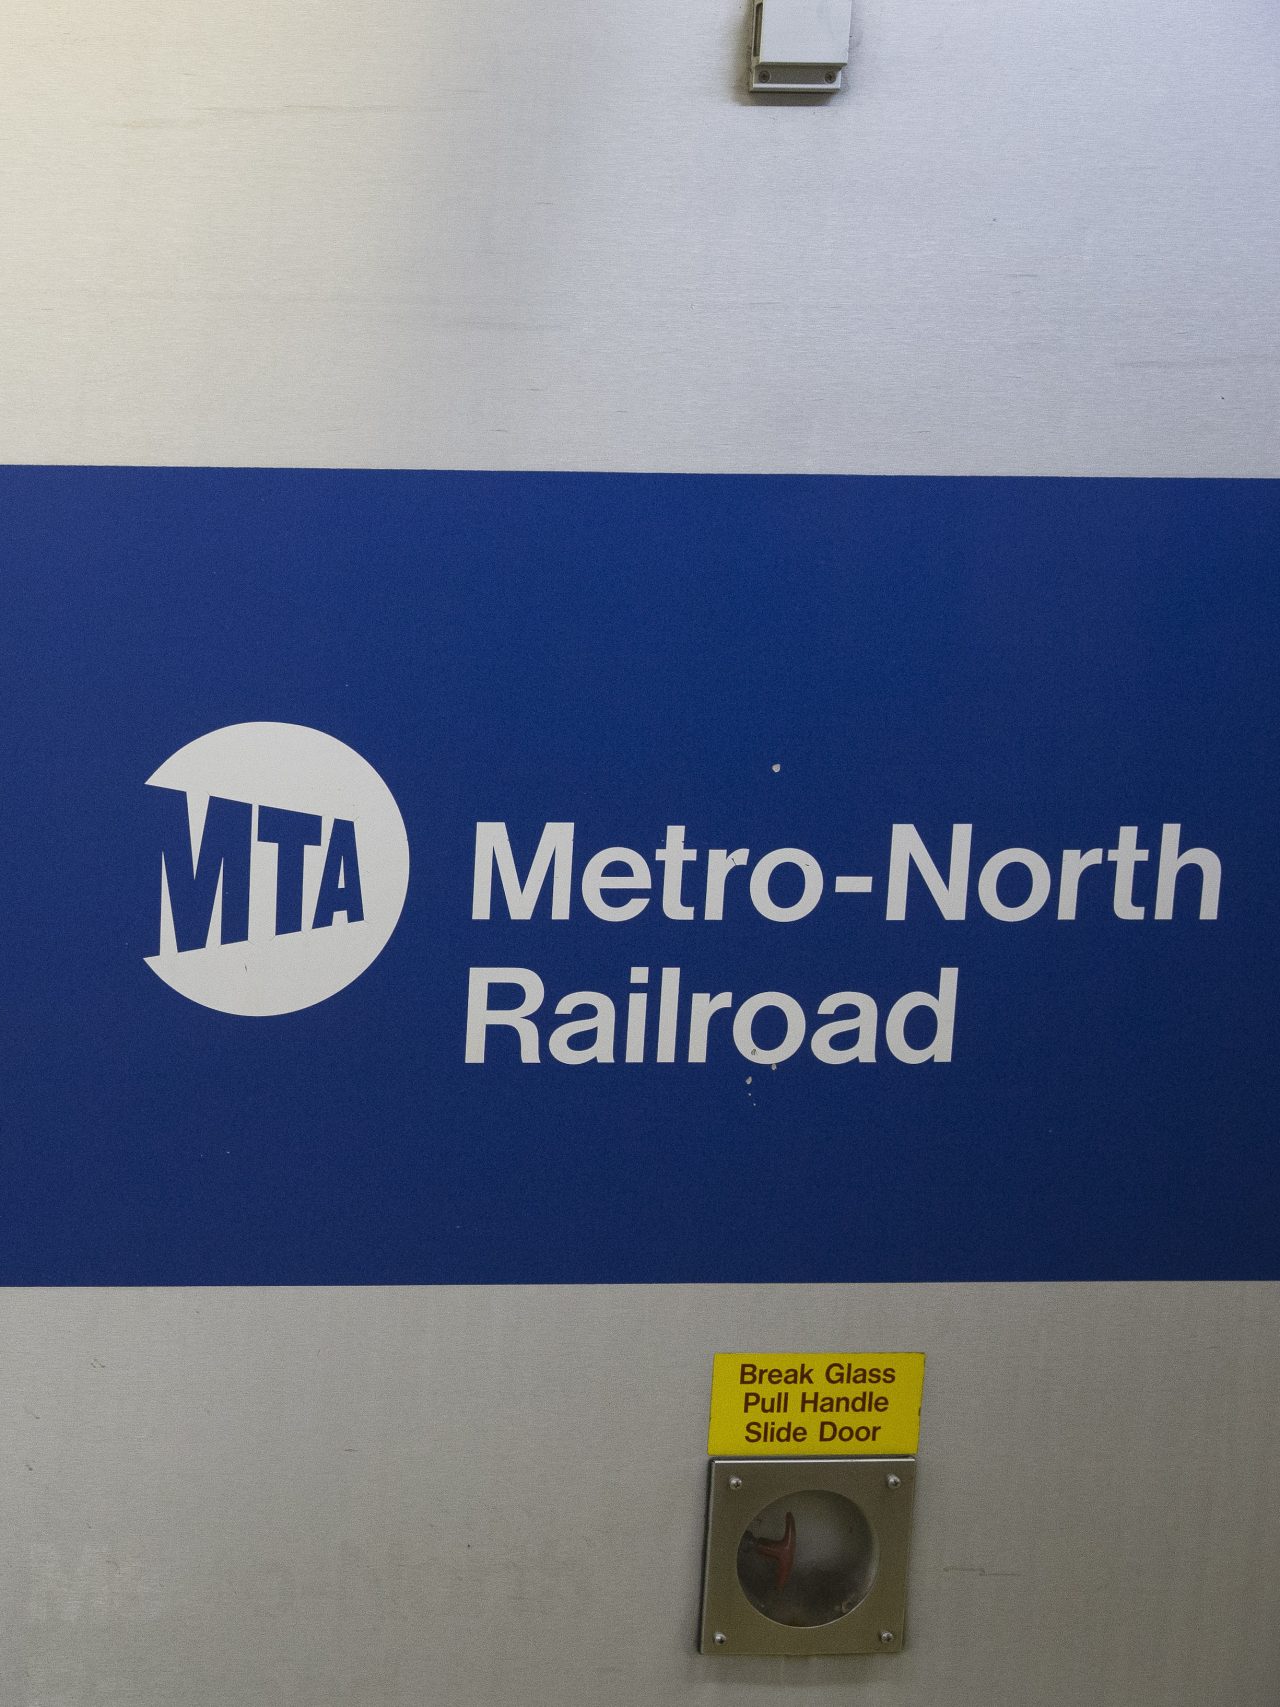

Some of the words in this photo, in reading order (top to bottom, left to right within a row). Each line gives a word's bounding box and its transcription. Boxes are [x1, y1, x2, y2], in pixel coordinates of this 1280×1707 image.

[157, 785, 365, 956] MTA
[471, 821, 1223, 923] Metro-North
[464, 966, 959, 1065] Railroad
[740, 1363, 814, 1385] Break
[825, 1362, 896, 1384] Glass
[743, 1392, 789, 1414] Pull
[801, 1391, 889, 1413] Handle
[744, 1421, 808, 1443] Slide
[819, 1421, 881, 1442] Door
